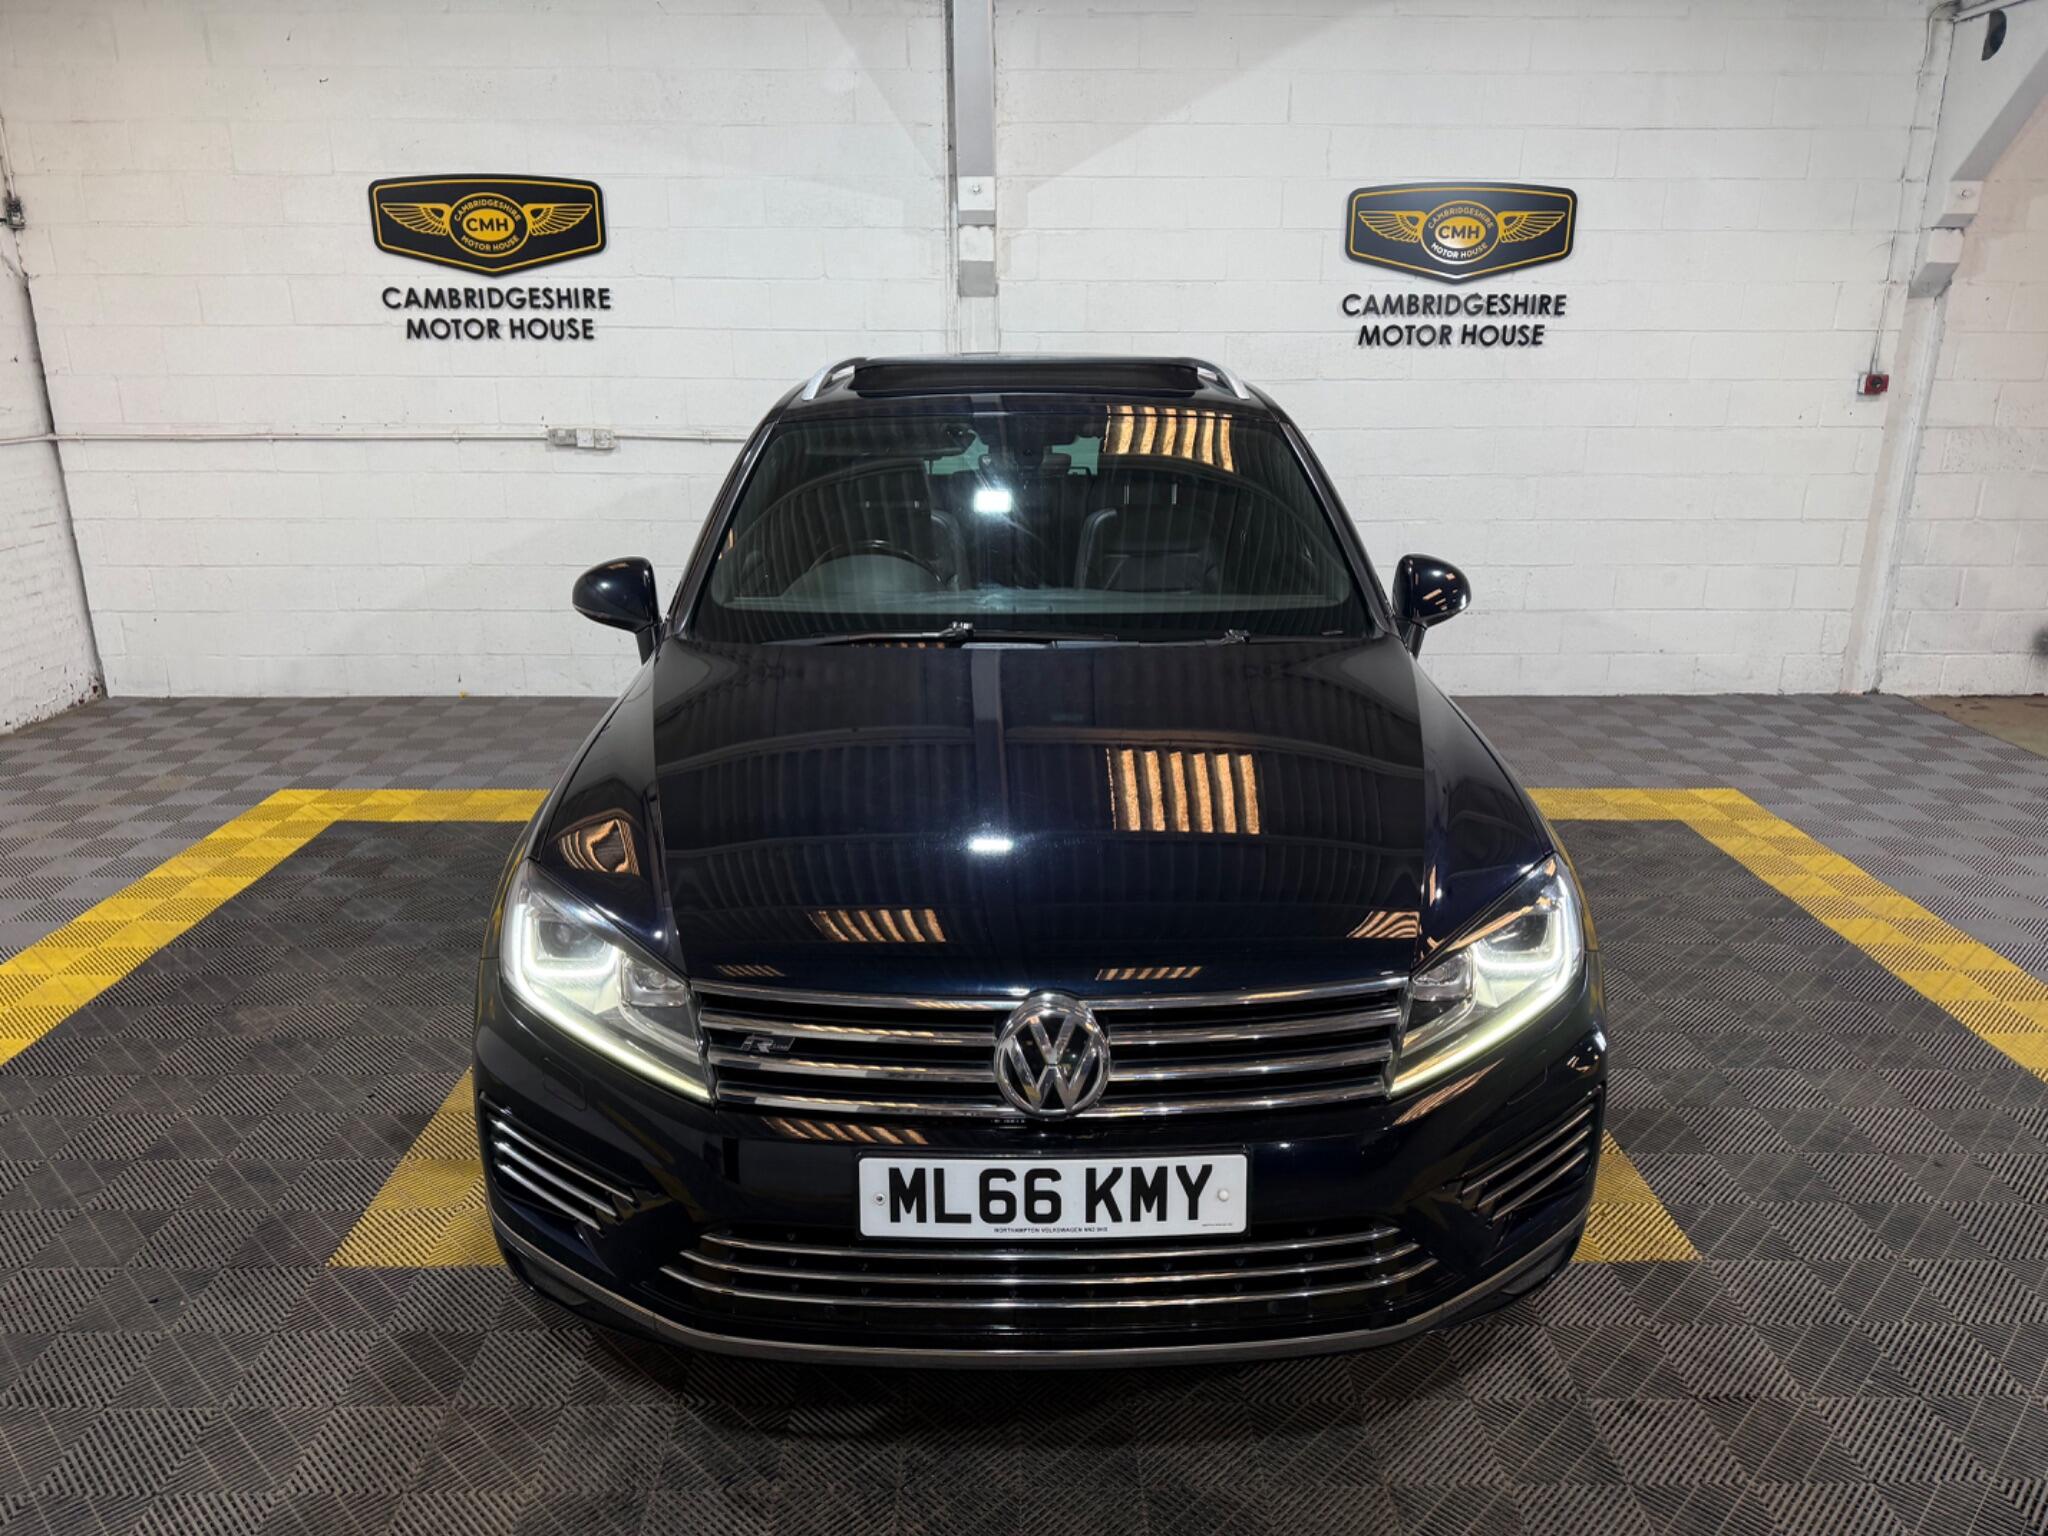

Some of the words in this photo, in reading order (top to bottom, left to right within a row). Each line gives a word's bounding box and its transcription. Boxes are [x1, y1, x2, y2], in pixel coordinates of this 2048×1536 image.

[454, 199, 521, 221] CAMBRIDGESHIRE
[1428, 207, 1494, 229] CAMBRIDGESHIRE
[466, 218, 508, 232] CMH
[1438, 225, 1480, 239] CMH
[461, 235, 491, 251] MOTOR
[493, 235, 519, 251] HOUSE
[1431, 242, 1459, 258] MOTOR
[1461, 242, 1488, 258] HOUSE
[382, 287, 612, 310] CAMBRIDGESHIRE
[1342, 293, 1567, 316] CAMBRIDGESHIRE
[407, 318, 501, 340] MOTOR
[510, 317, 595, 341] HOUSE
[1358, 324, 1453, 346] MOTOR
[1461, 323, 1546, 346] HOUSE
[888, 1167, 1062, 1224] ML66
[1085, 1164, 1213, 1223] KMY
